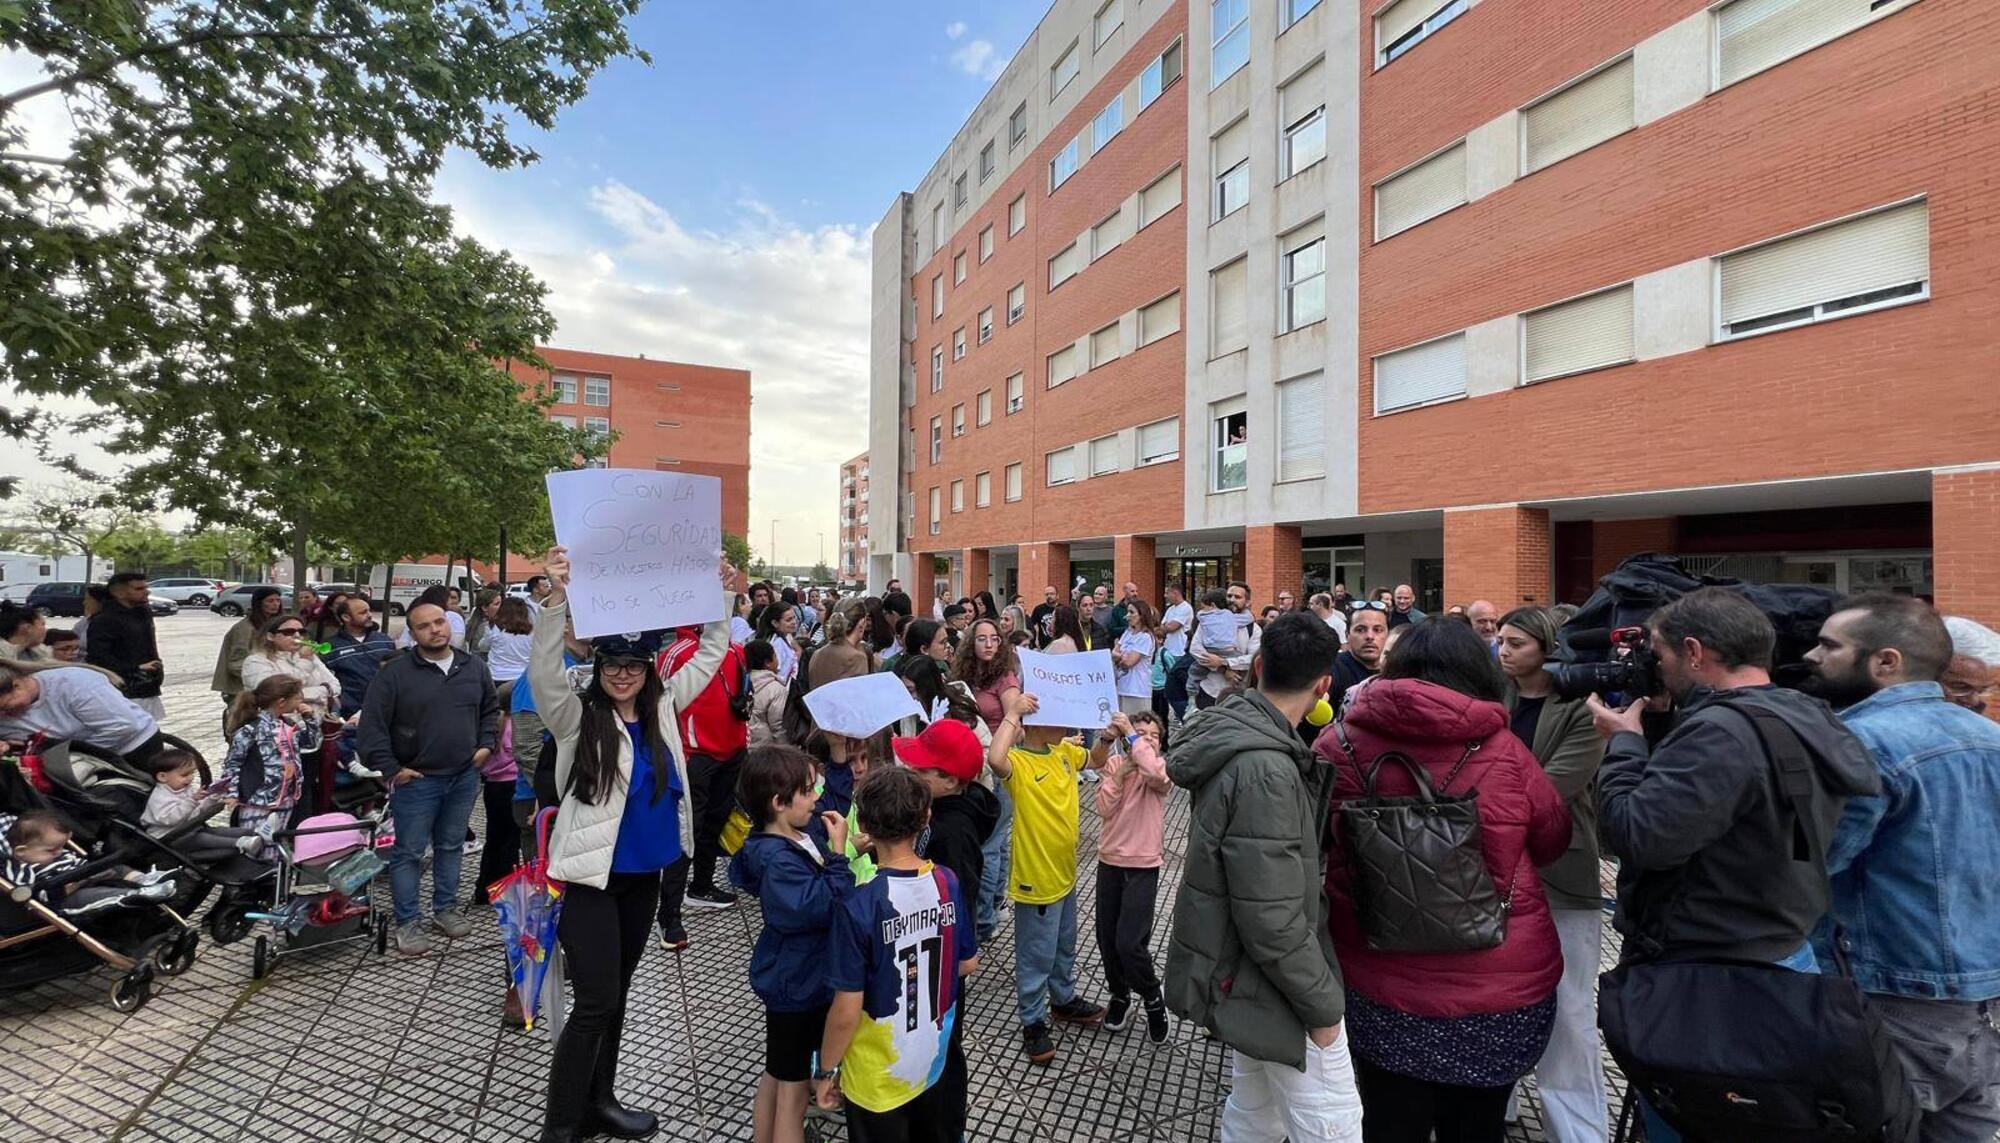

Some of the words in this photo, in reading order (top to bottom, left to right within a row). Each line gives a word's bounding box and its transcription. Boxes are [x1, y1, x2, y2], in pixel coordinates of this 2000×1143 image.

[611, 473, 662, 499] CON
[673, 478, 696, 502] LA
[898, 935, 944, 1033] 11
